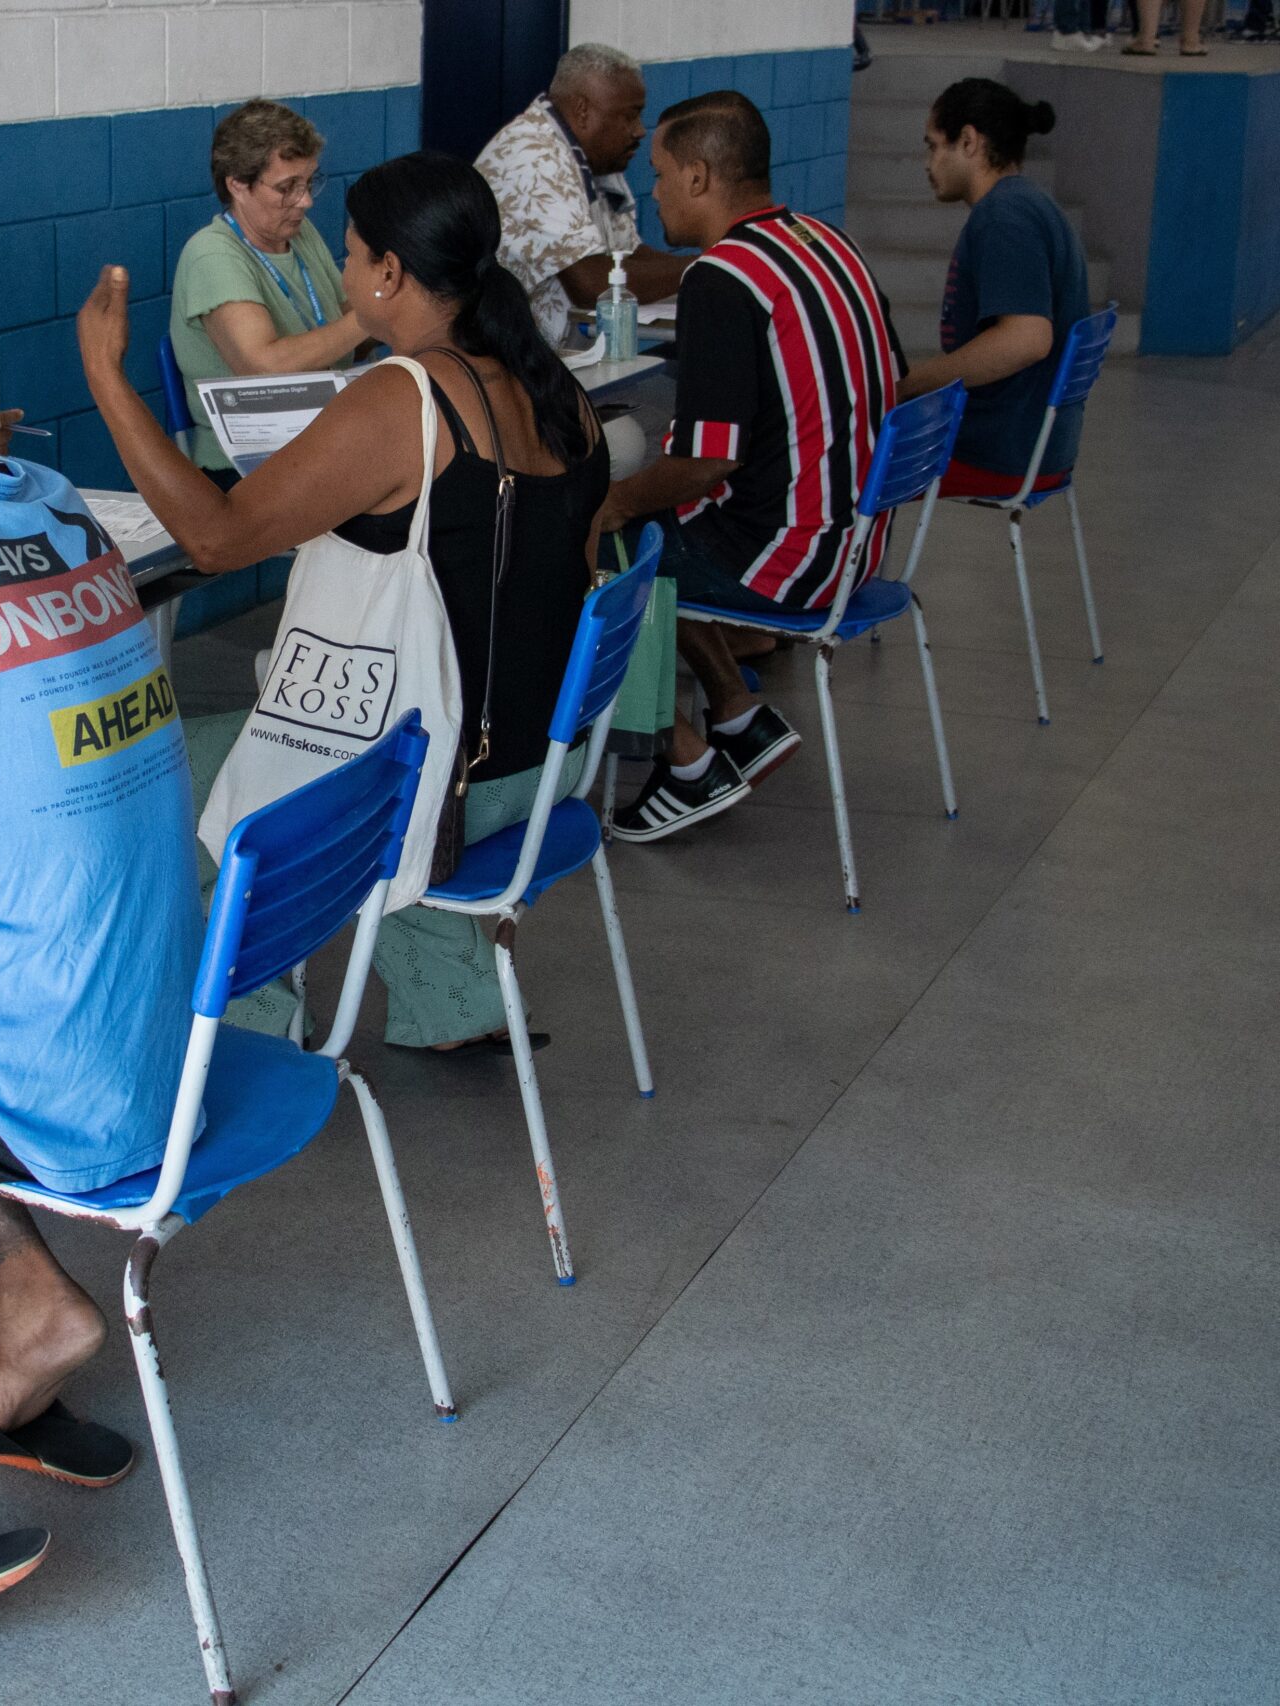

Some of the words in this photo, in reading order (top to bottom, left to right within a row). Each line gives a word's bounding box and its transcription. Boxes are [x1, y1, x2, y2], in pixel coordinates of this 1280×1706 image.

[42, 677, 56, 685] THE
[59, 666, 90, 681] FOUNDER
[284, 643, 383, 694] FISS
[20, 693, 36, 703] AND
[38, 684, 74, 698] FOUNDED
[77, 679, 90, 688] THE
[273, 678, 373, 724] KOSS
[73, 673, 174, 757] AHEAD
[65, 782, 99, 795] ONBONGO
[708, 783, 732, 798] adidas
[51, 796, 85, 809] PRODUCT
[66, 809, 82, 818] WAS
